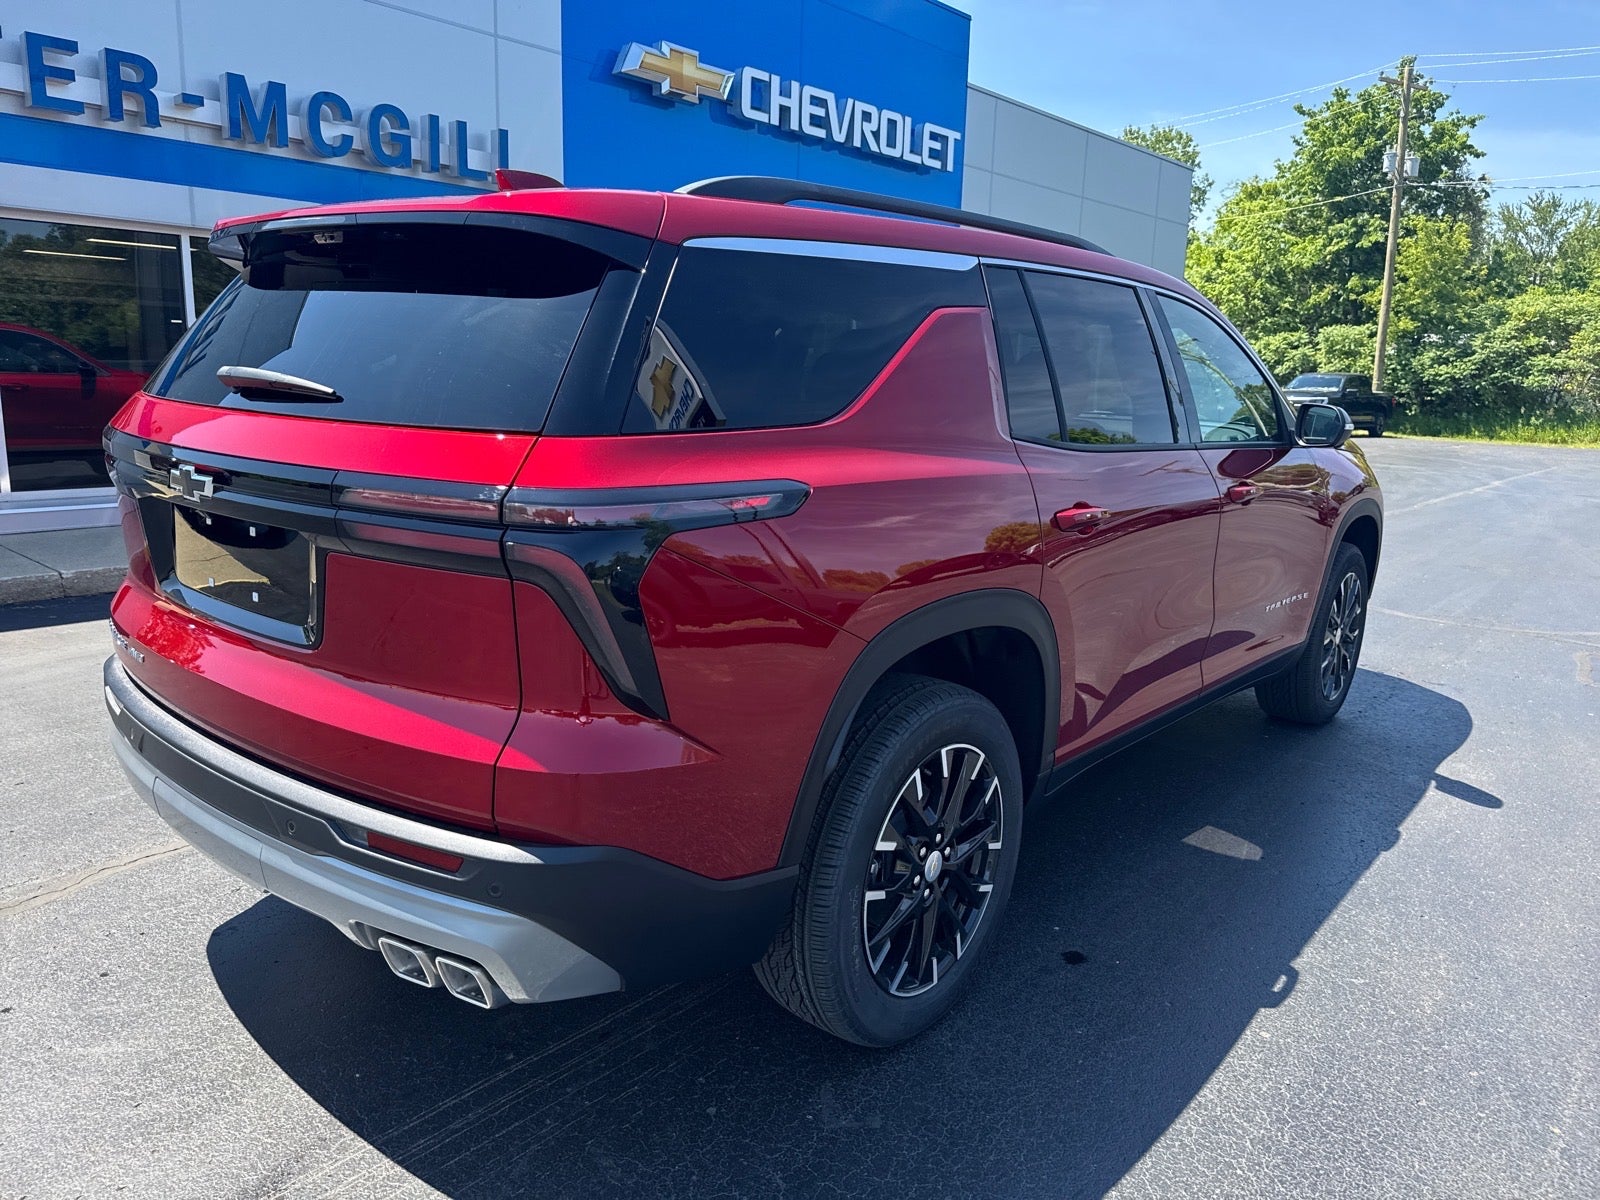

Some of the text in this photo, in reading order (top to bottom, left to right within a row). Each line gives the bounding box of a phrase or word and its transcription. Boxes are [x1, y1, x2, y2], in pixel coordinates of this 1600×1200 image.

[0, 25, 509, 183] ER-MCGIL
[740, 66, 962, 172] CHEVROLET
[1265, 592, 1309, 612] TRAVERSE
